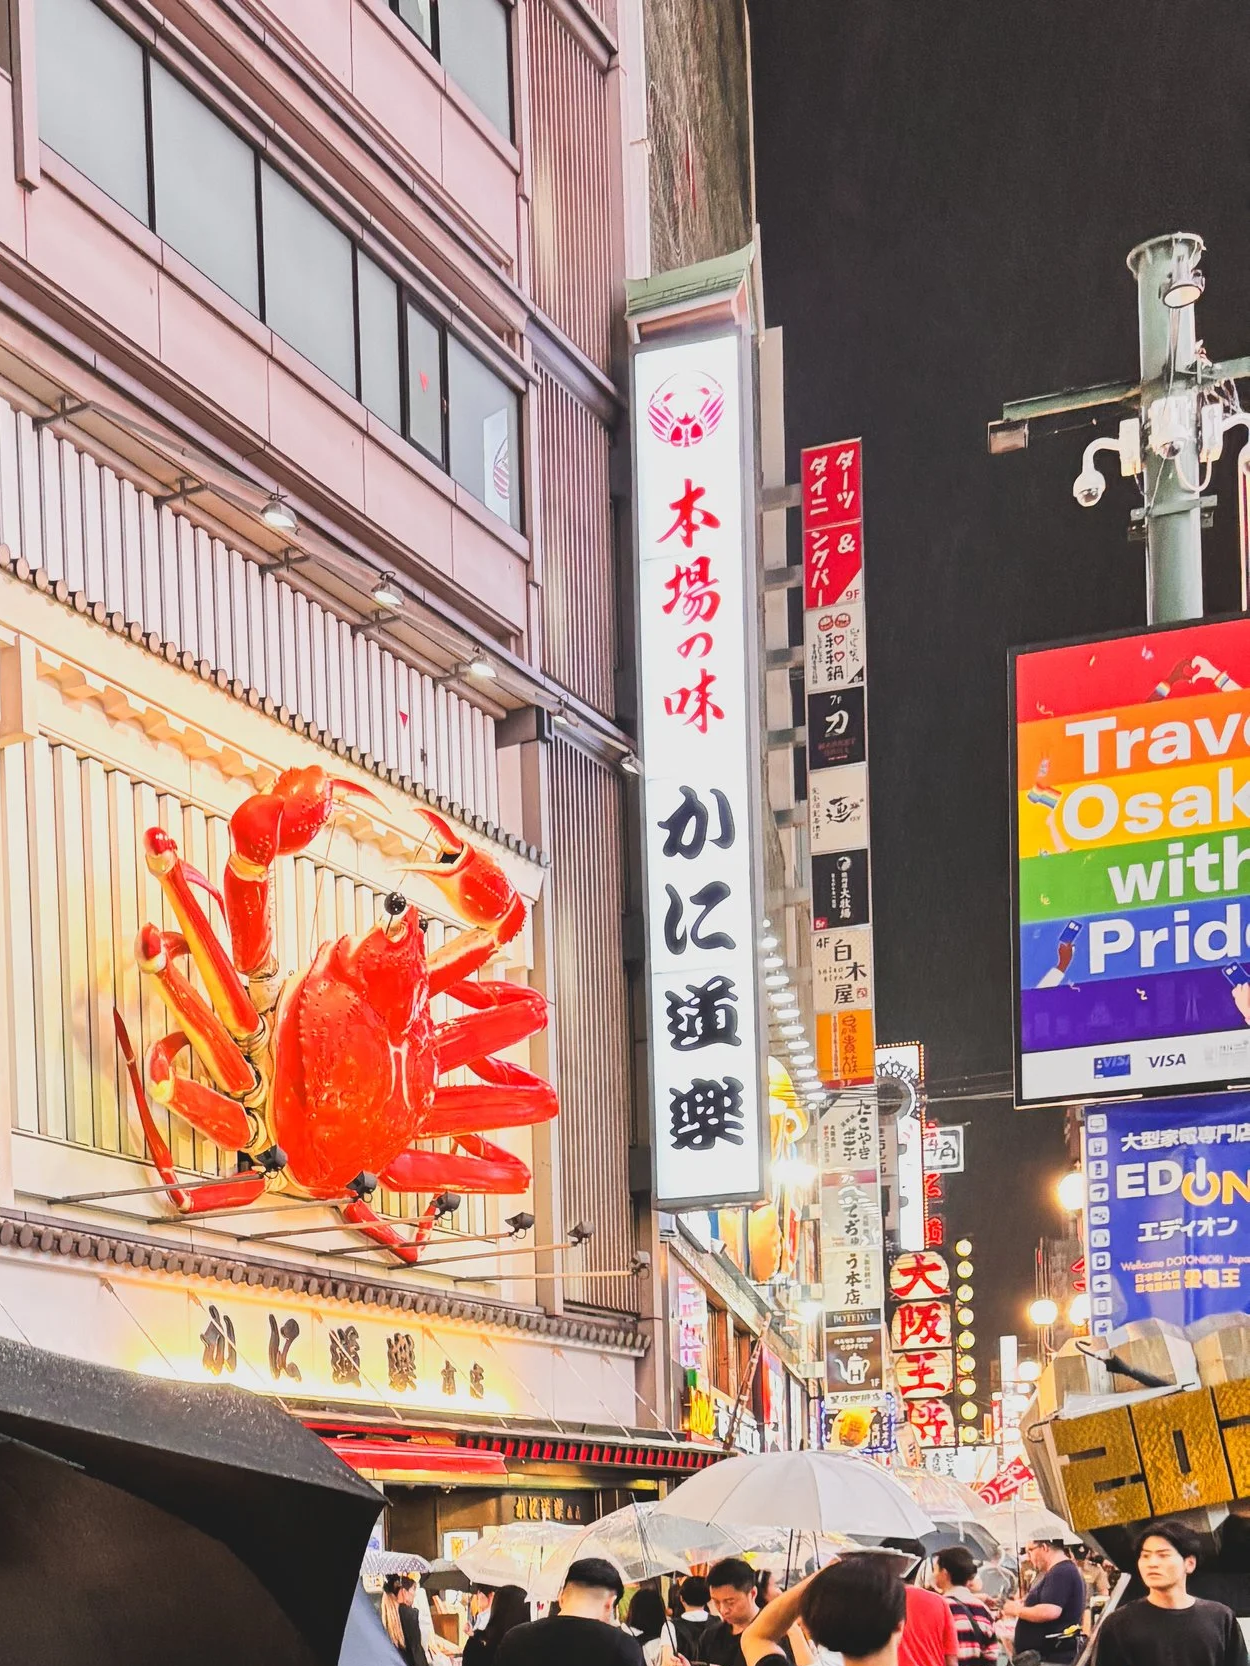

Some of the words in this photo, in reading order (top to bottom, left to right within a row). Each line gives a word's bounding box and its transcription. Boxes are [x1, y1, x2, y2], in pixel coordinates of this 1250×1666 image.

[835, 449, 855, 510] ダーツ
[809, 455, 831, 608] ダイニングバー
[656, 478, 726, 736] 本場の味
[845, 589, 861, 601] 9F
[1065, 711, 1250, 775] Trav
[816, 937, 830, 949] 4F
[1088, 904, 1250, 975] Prid
[834, 939, 867, 1005] 白木屋
[1147, 1053, 1187, 1069] VISA
[1137, 1216, 1238, 1243] エディオン
[840, 1343, 868, 1351] COFFEE
[870, 1378, 880, 1387] 1F
